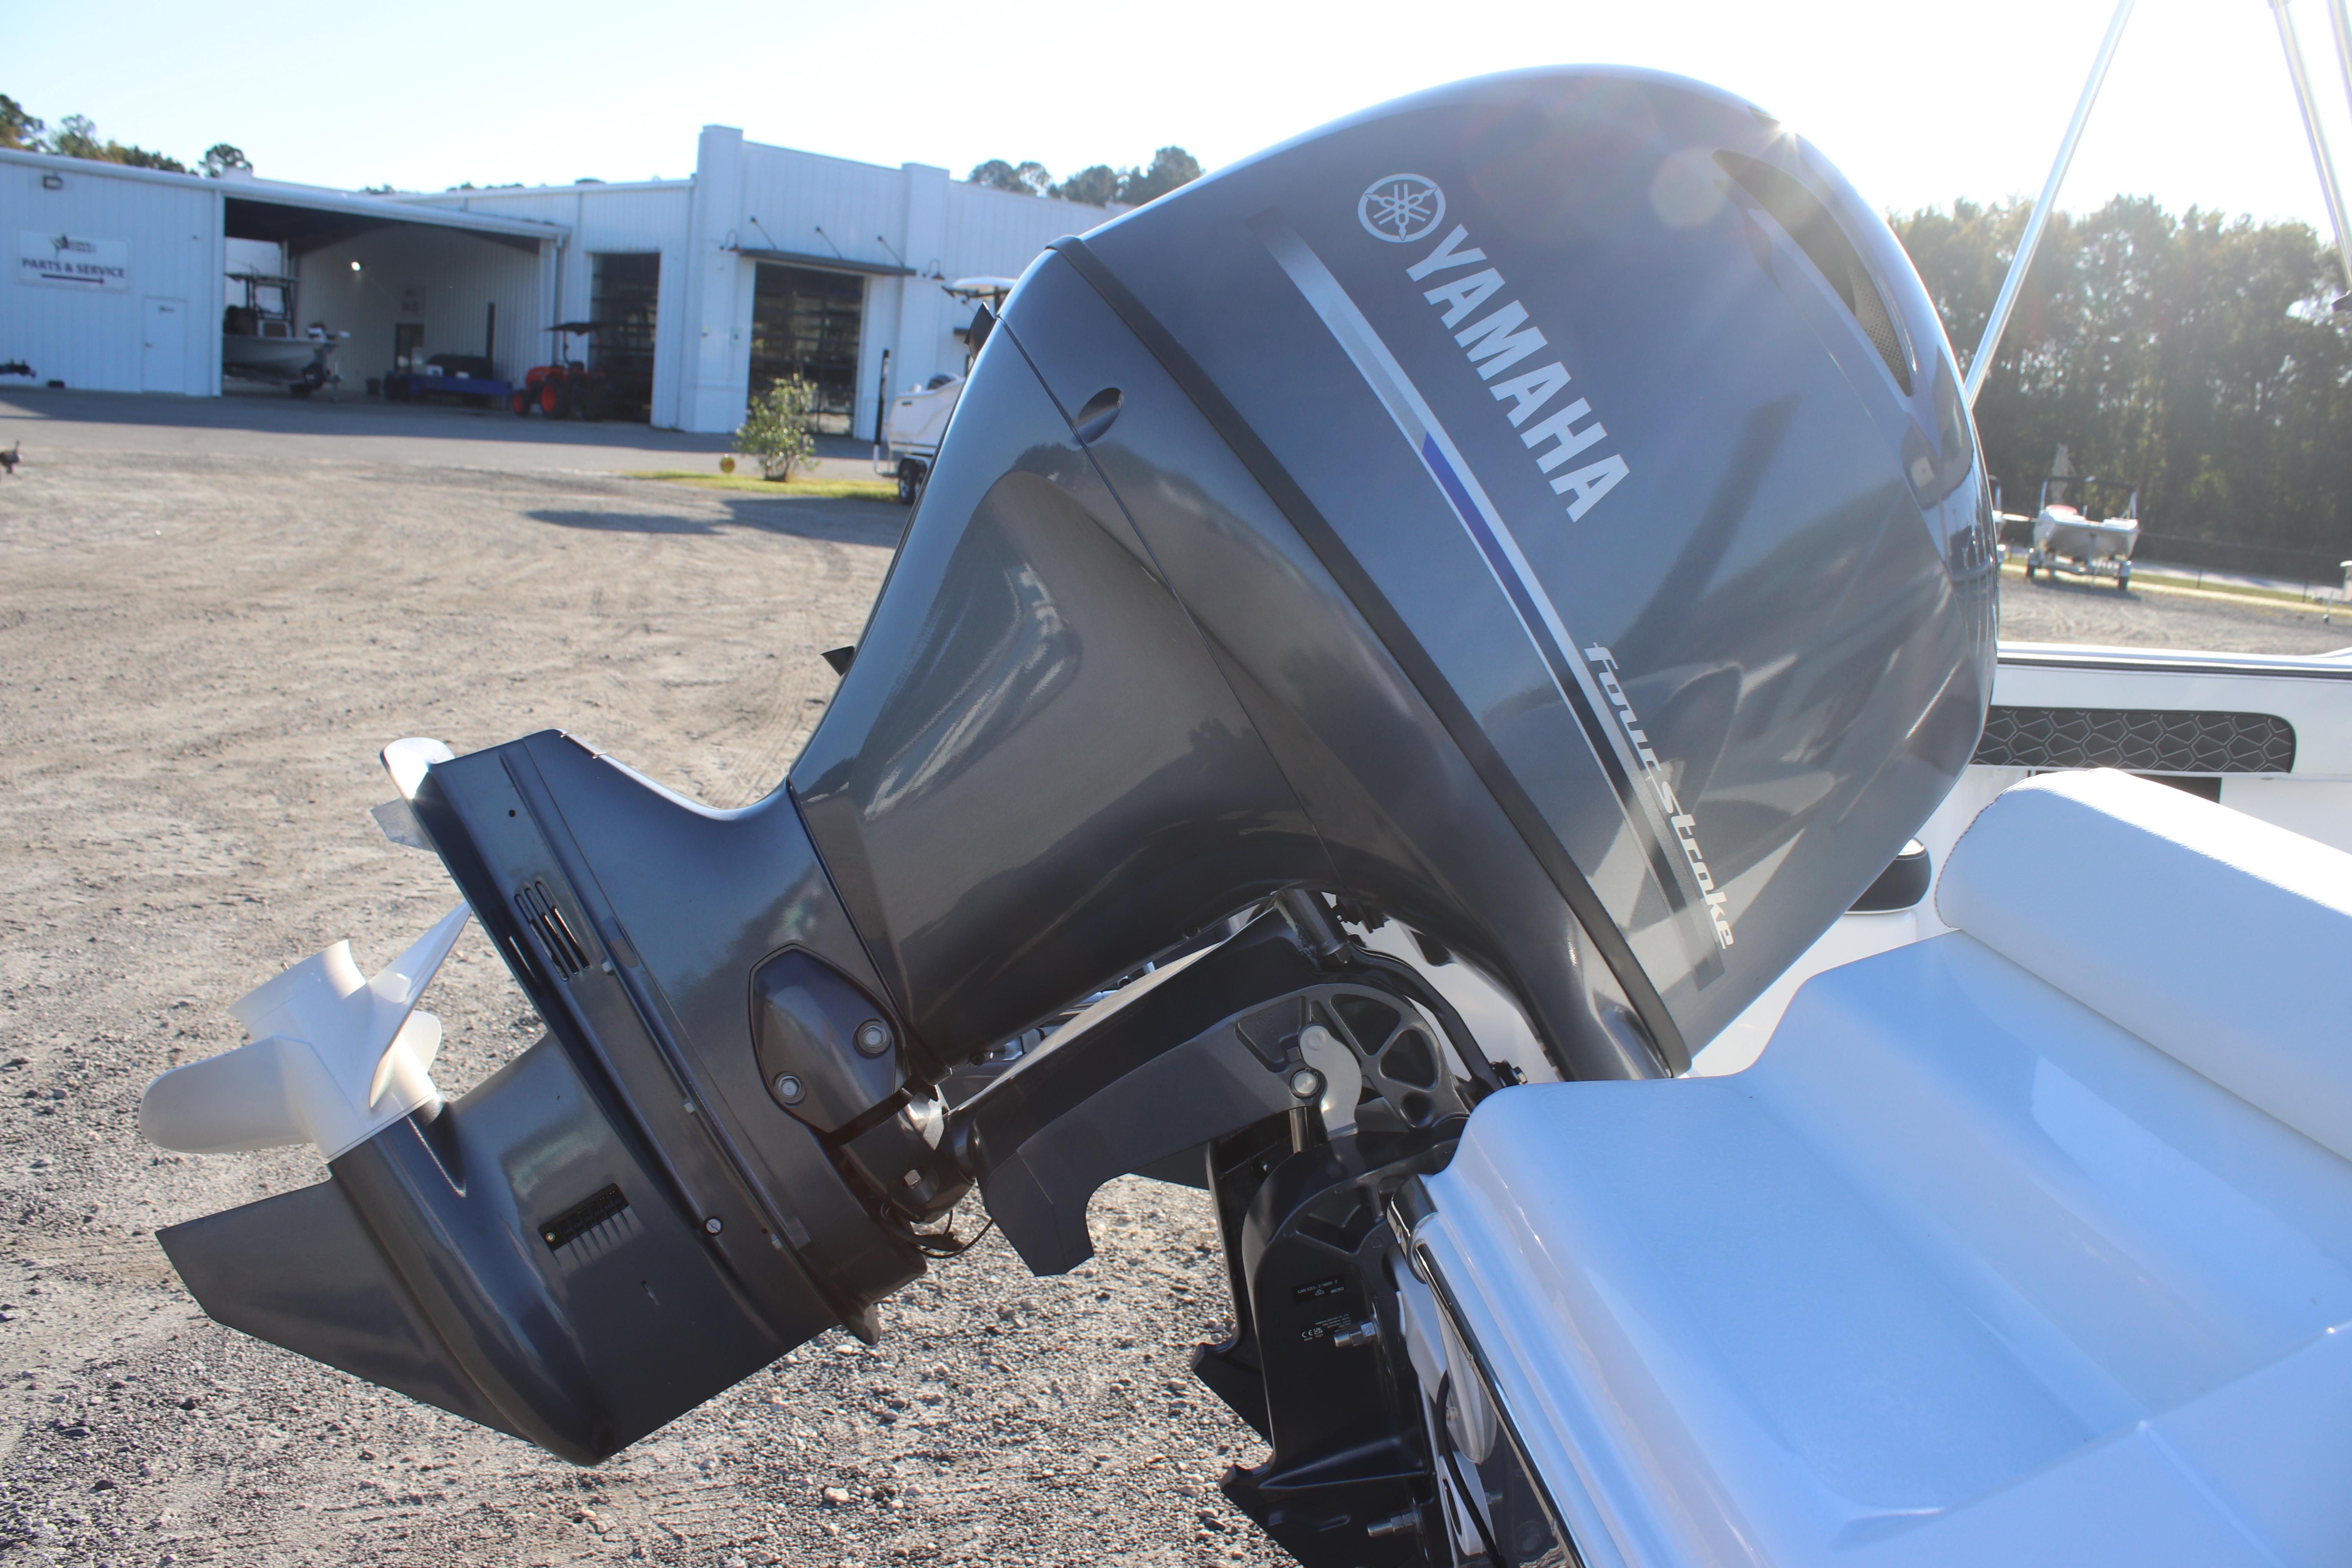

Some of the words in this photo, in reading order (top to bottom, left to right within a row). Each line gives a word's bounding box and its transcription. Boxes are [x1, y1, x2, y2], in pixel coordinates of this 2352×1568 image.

[22, 257, 62, 272] PARTS
[64, 262, 74, 273] &
[76, 263, 125, 278] SERVICE
[1406, 224, 1630, 523] YAMAHA
